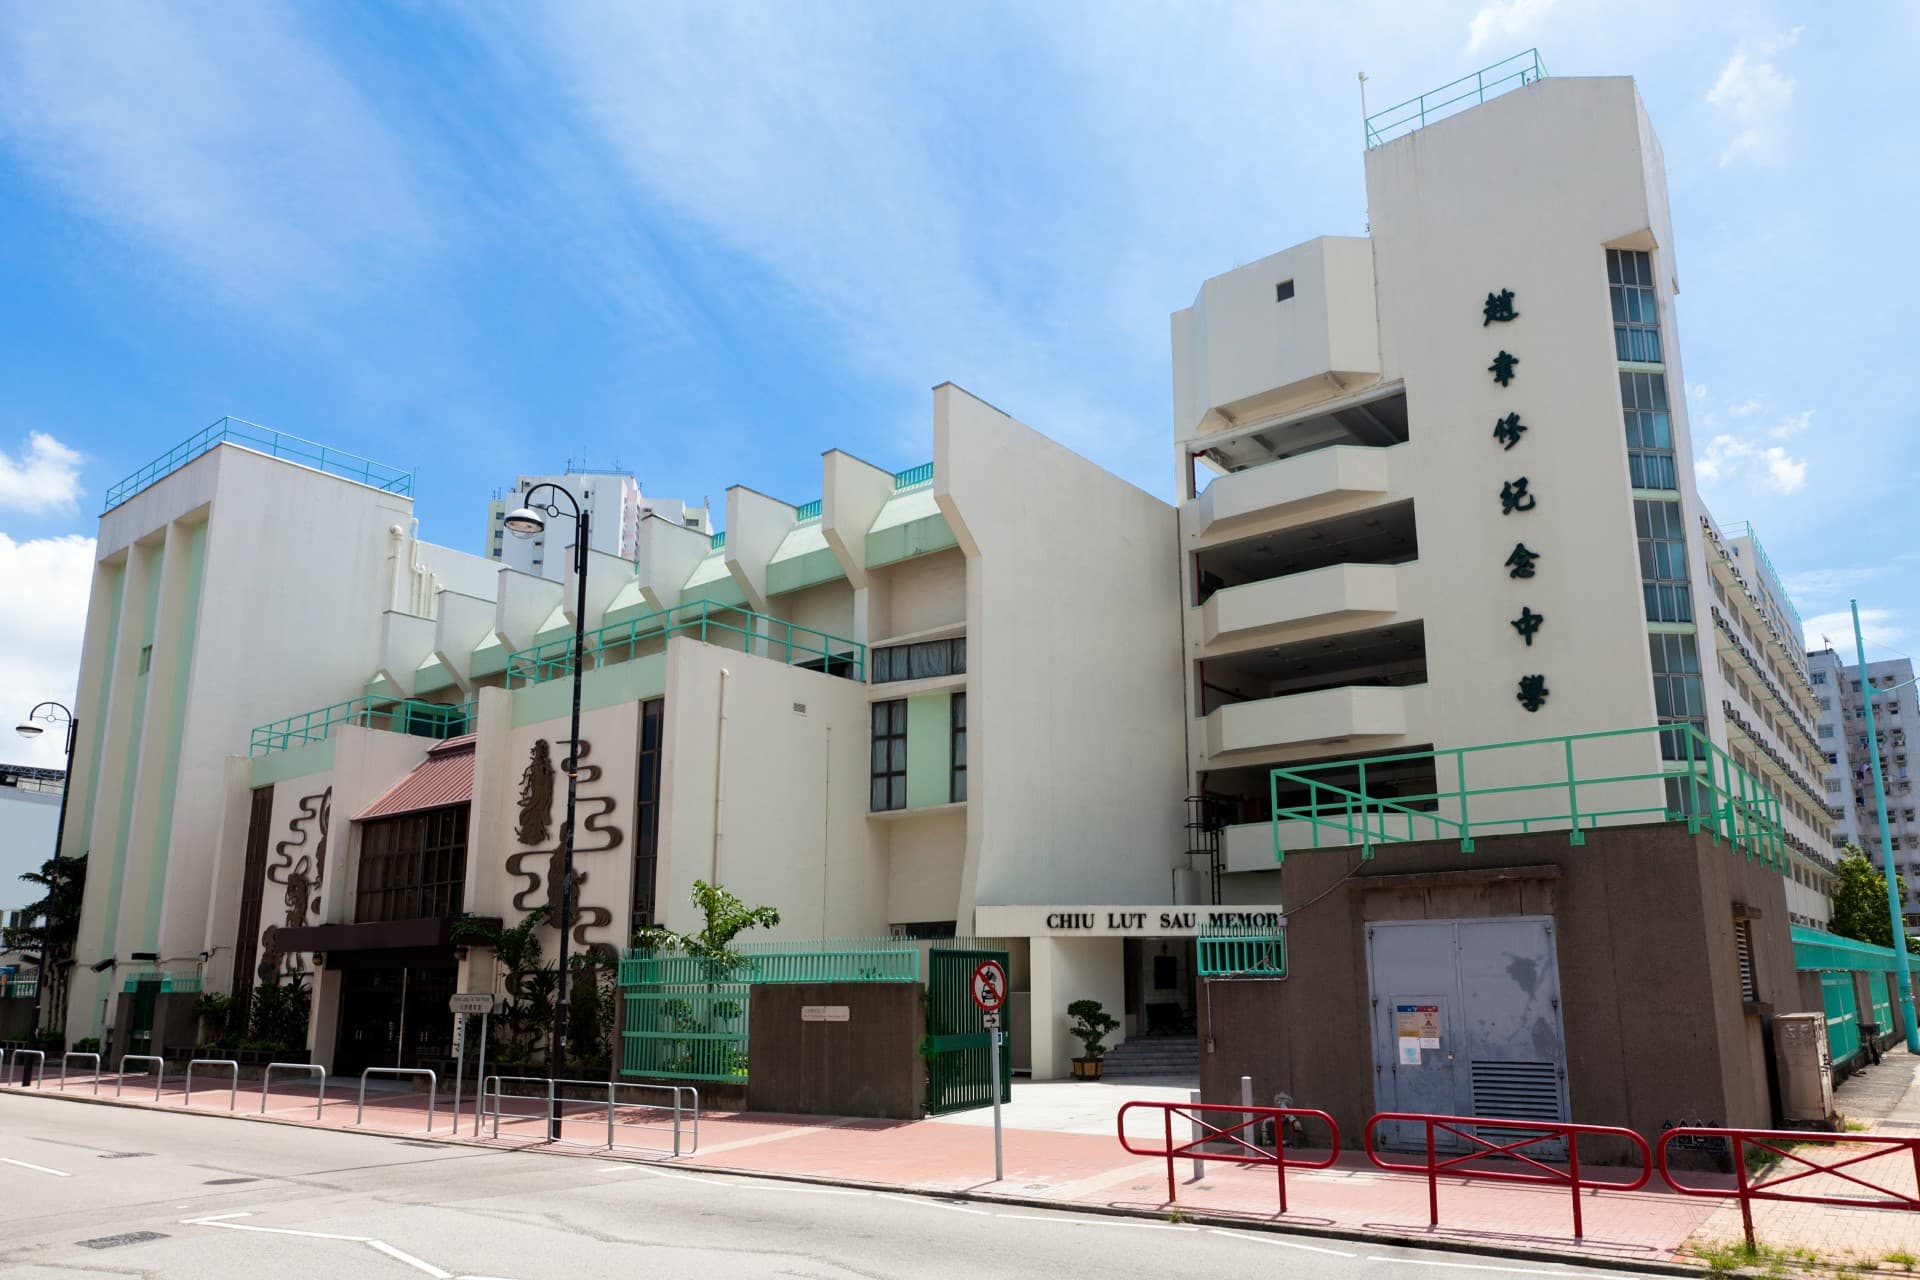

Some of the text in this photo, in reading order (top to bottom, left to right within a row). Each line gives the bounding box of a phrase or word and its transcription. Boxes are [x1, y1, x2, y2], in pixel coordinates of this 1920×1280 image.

[1482, 287, 1550, 713] 趙聿修紀念中學
[1046, 912, 1095, 930] CHIU
[1107, 912, 1148, 930] LUT
[1159, 912, 1197, 929] SAU
